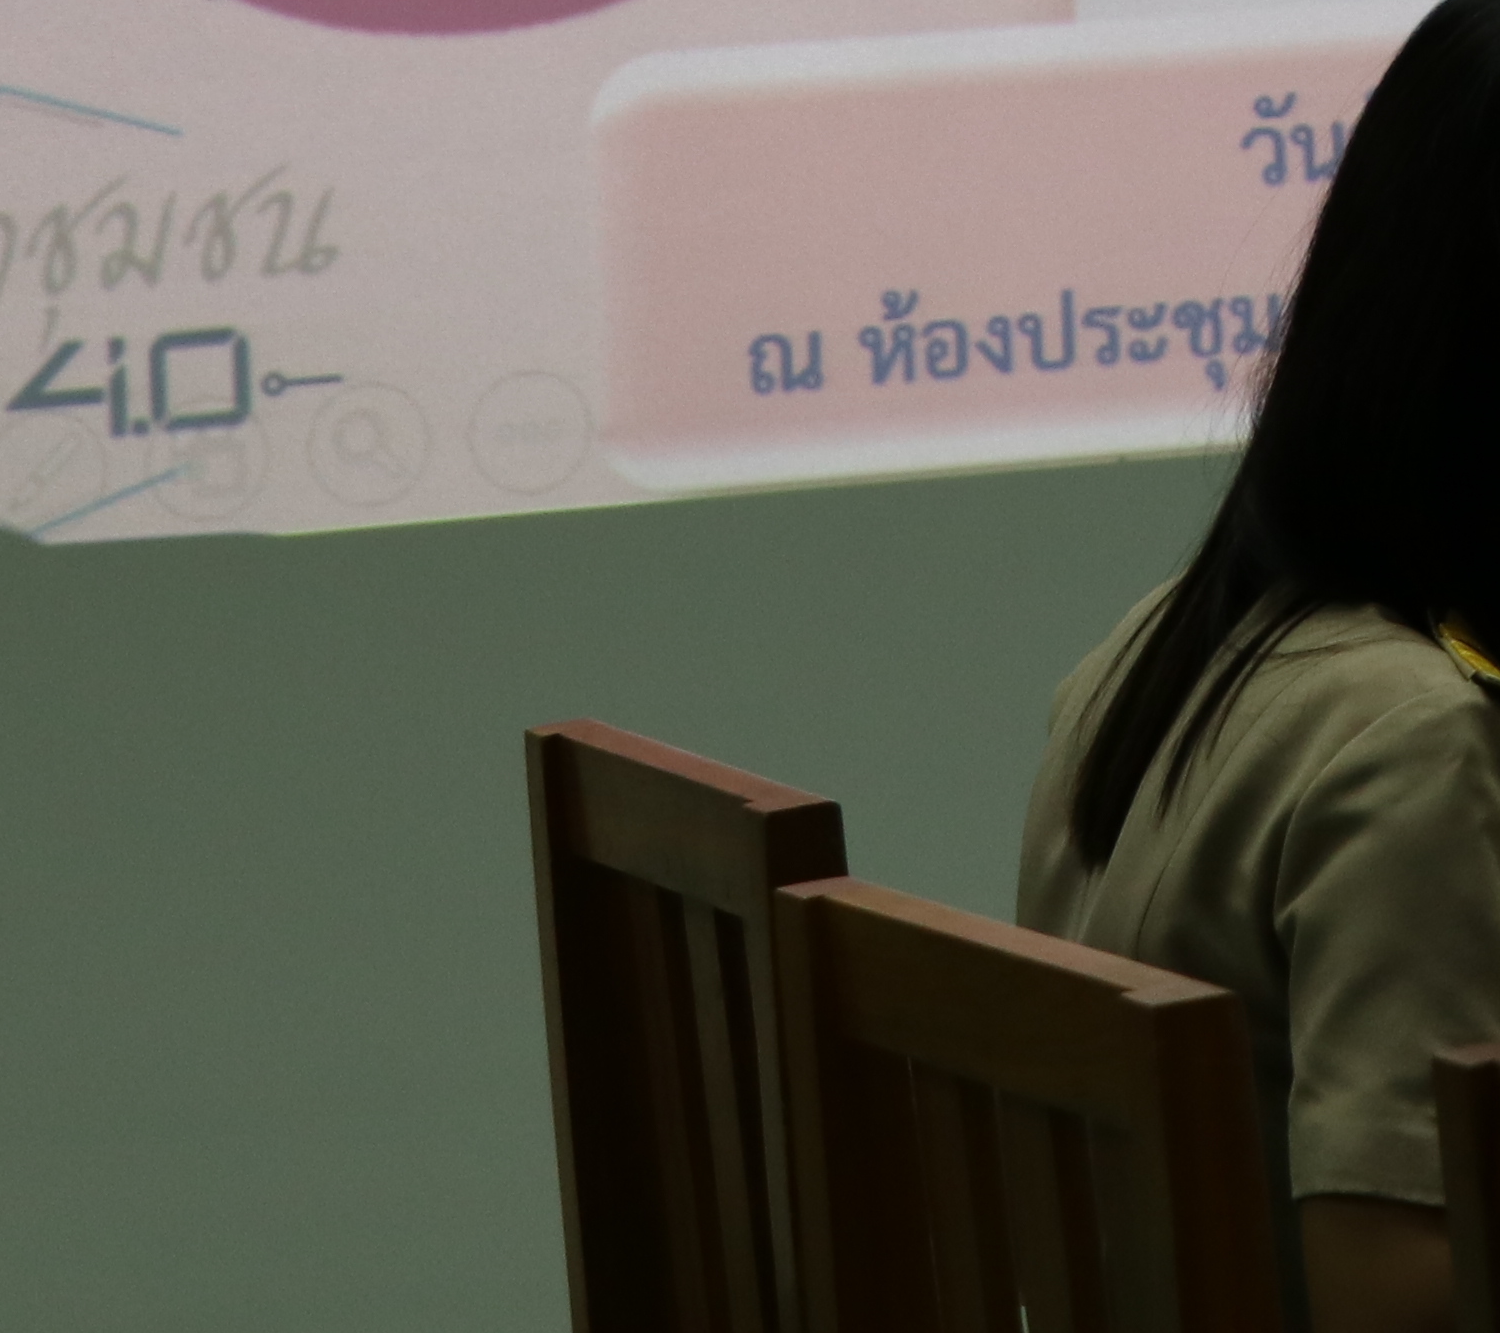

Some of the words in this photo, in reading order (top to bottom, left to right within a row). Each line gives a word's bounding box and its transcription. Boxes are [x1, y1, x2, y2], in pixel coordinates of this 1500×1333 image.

[1241, 91, 1352, 186] วัน
[747, 329, 826, 394] ณ
[855, 287, 1292, 393] ห้องประชุม
